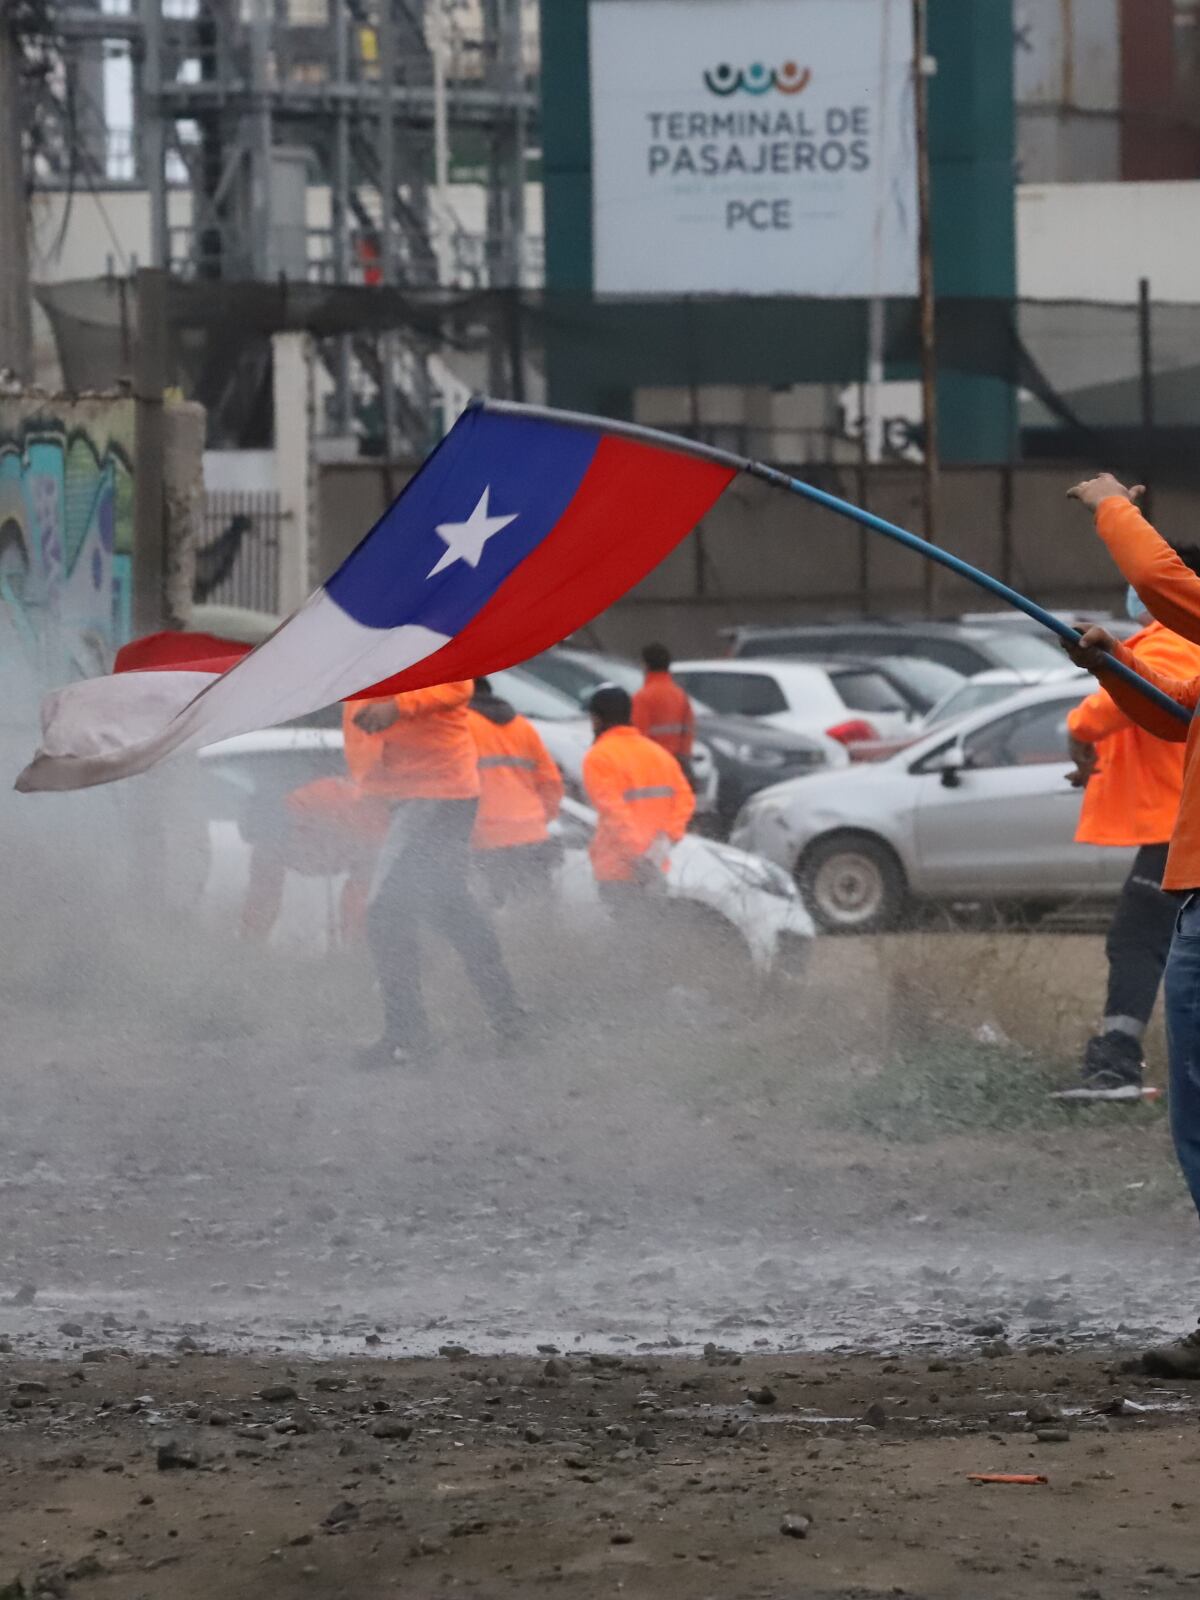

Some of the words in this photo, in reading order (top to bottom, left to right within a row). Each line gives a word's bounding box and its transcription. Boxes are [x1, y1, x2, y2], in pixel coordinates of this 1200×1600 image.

[647, 110, 814, 140] TERMINAL
[825, 106, 870, 137] DE
[648, 139, 870, 176] PASAJEROS
[725, 199, 792, 231] PCE
